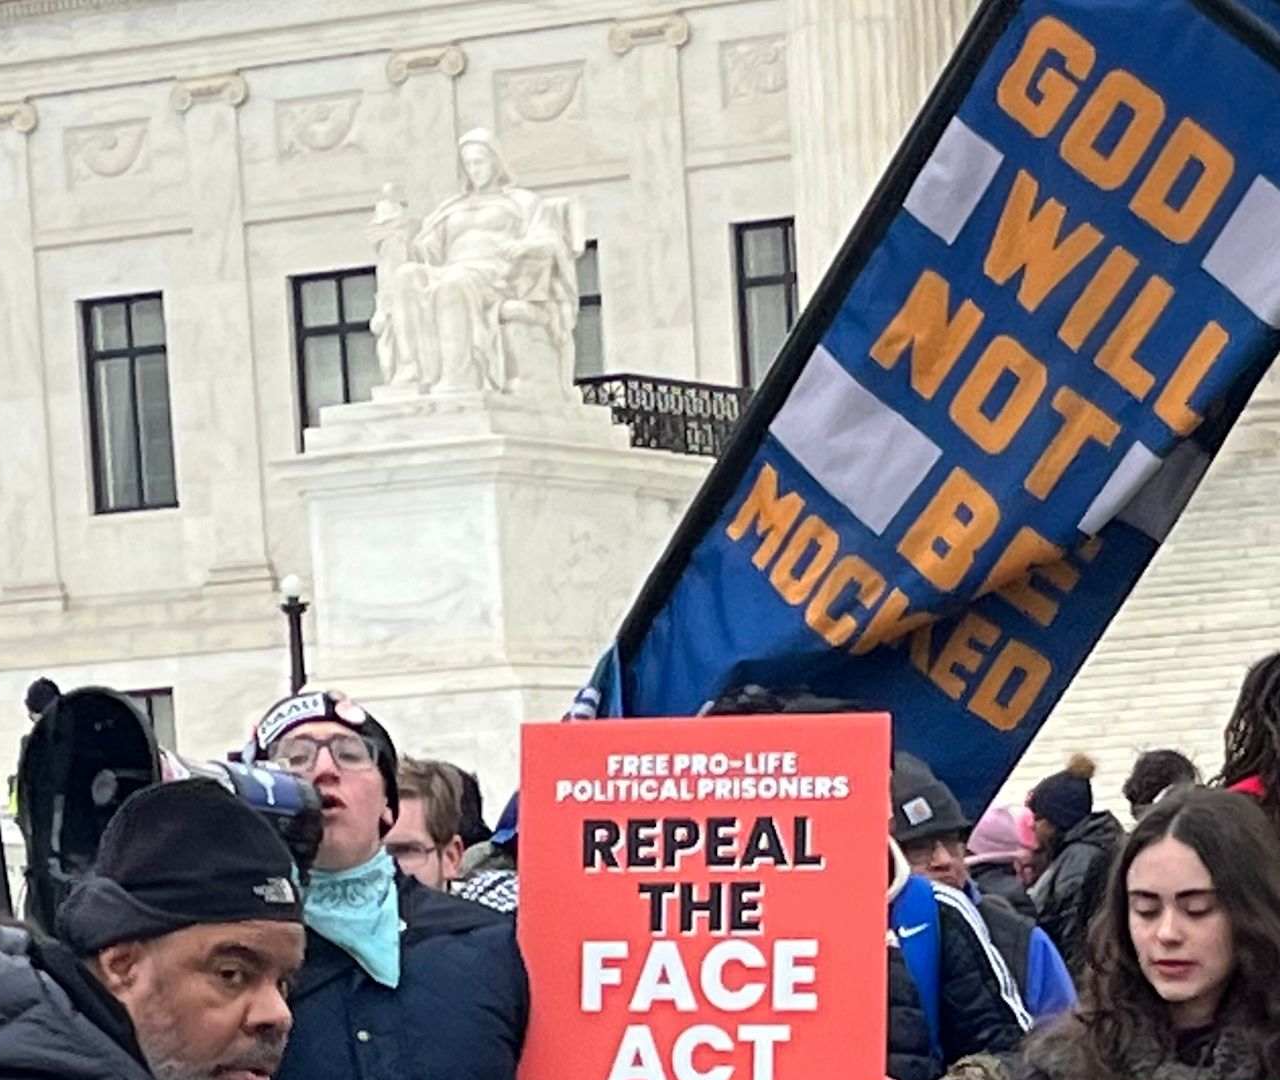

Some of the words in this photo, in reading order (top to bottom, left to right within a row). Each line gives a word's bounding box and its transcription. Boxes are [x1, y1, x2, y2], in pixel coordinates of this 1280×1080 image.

[998, 15, 1235, 244] GOD
[984, 170, 1228, 436] WILL
[871, 271, 1121, 499] NOT
[725, 463, 1051, 731] MOCKED
[896, 468, 1102, 626] BE
[555, 778, 694, 803] POLITICAL
[696, 776, 850, 800] PRISONERS
[607, 753, 670, 777] FREE
[673, 751, 797, 775] PRO-LIFE
[582, 816, 826, 873] REPEAL
[638, 881, 764, 937] THE
[580, 938, 818, 1013] FACE
